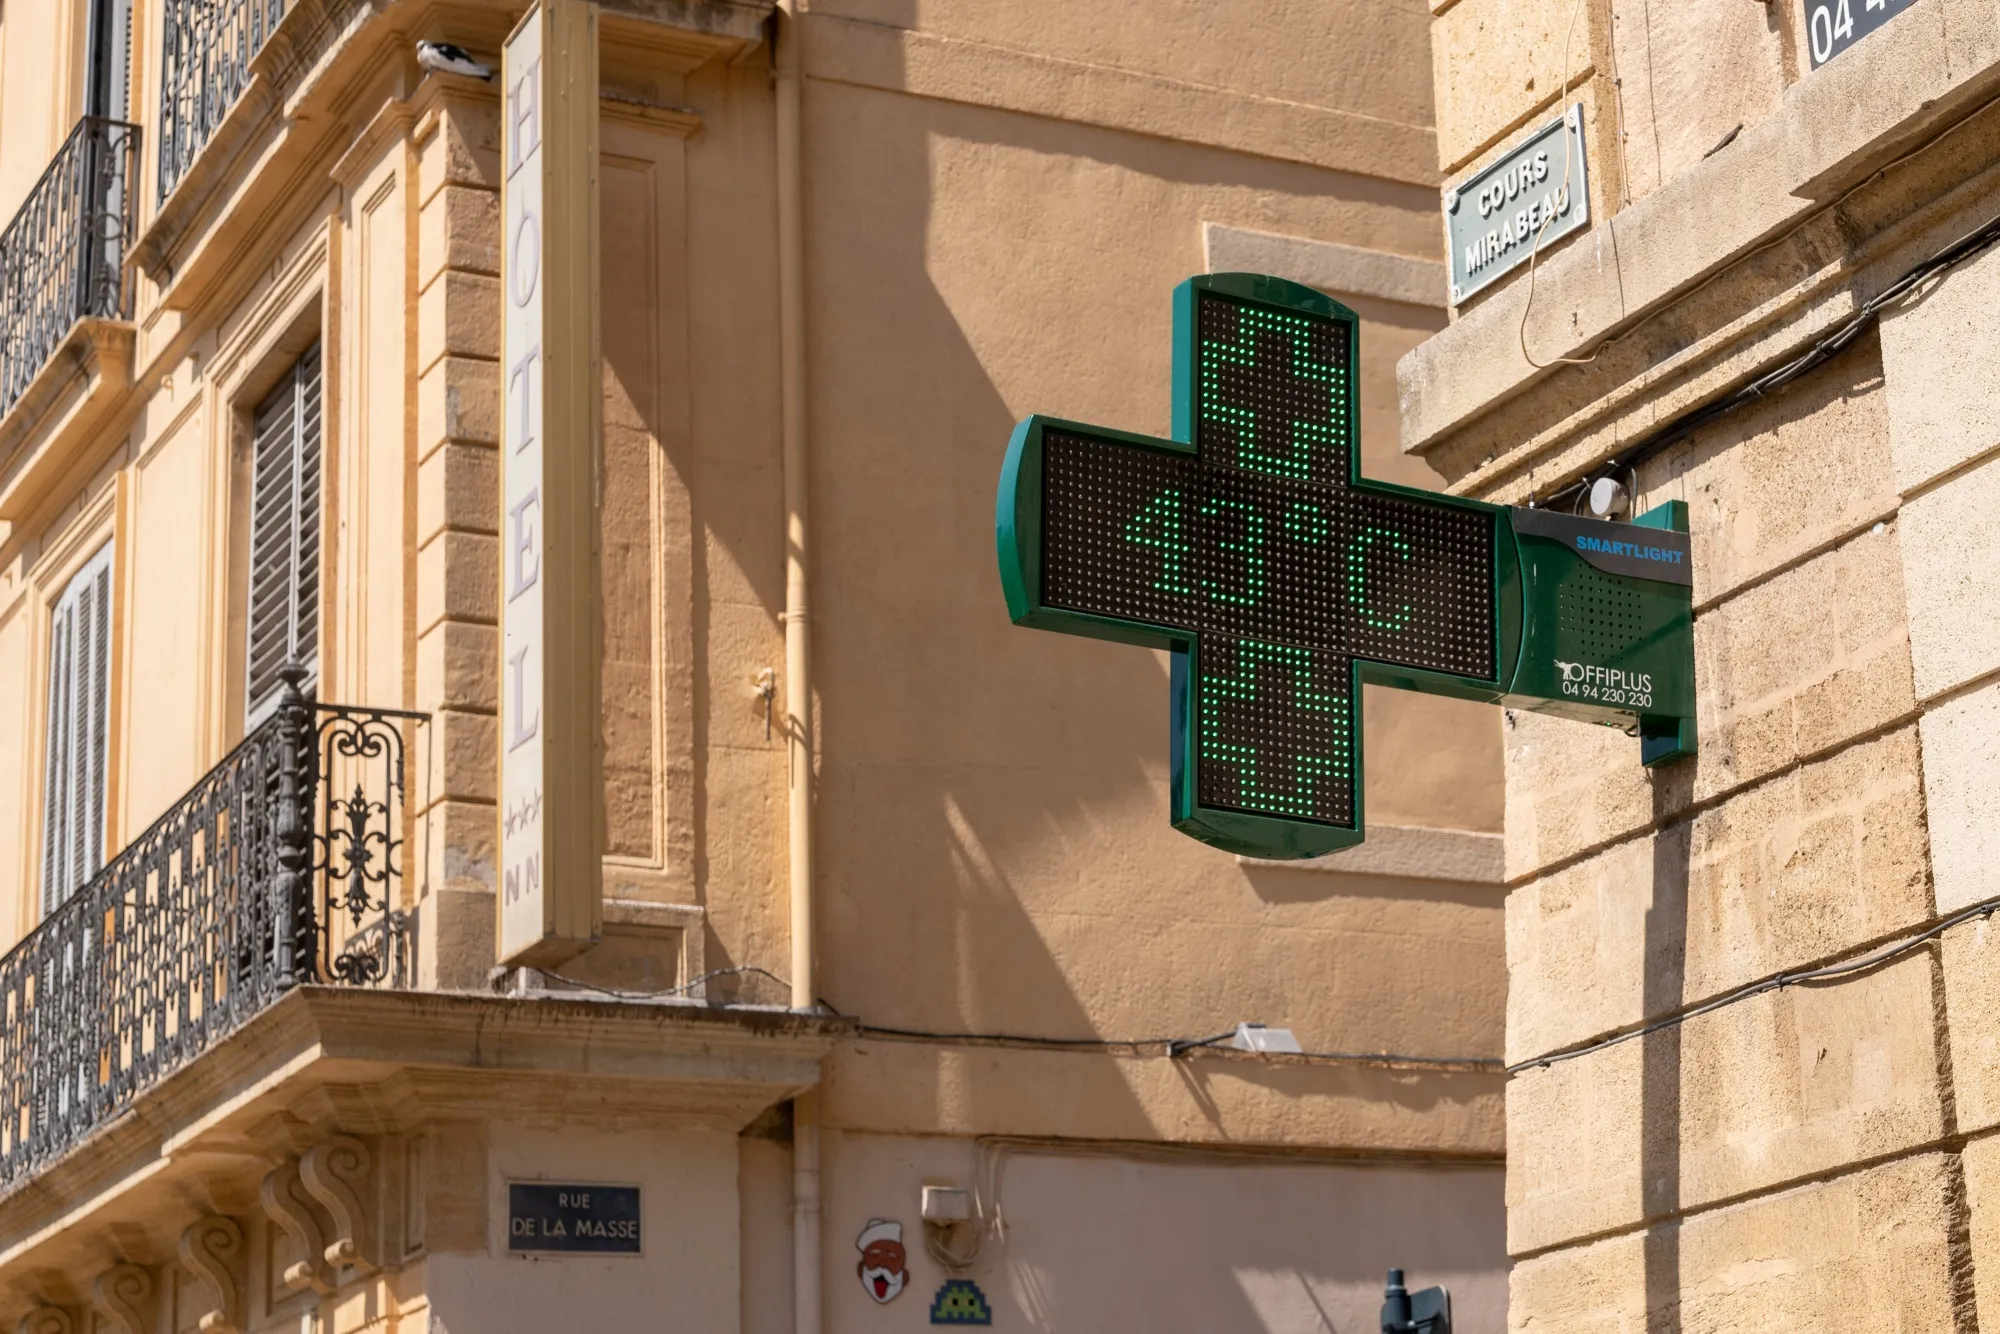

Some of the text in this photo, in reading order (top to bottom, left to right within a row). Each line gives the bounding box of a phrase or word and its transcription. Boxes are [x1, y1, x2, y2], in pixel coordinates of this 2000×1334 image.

[1478, 150, 1548, 217] COURS
[1465, 184, 1570, 274] MIRABEAU
[506, 55, 541, 755] HOTEL
[1576, 535, 1683, 565] SMARTLIGHT
[1569, 662, 1652, 693] OFFIPLUS
[1562, 681, 1652, 708] 04 94 230 230
[559, 1193, 591, 1208] RUE
[512, 1218, 638, 1239] DE LA MASSE
